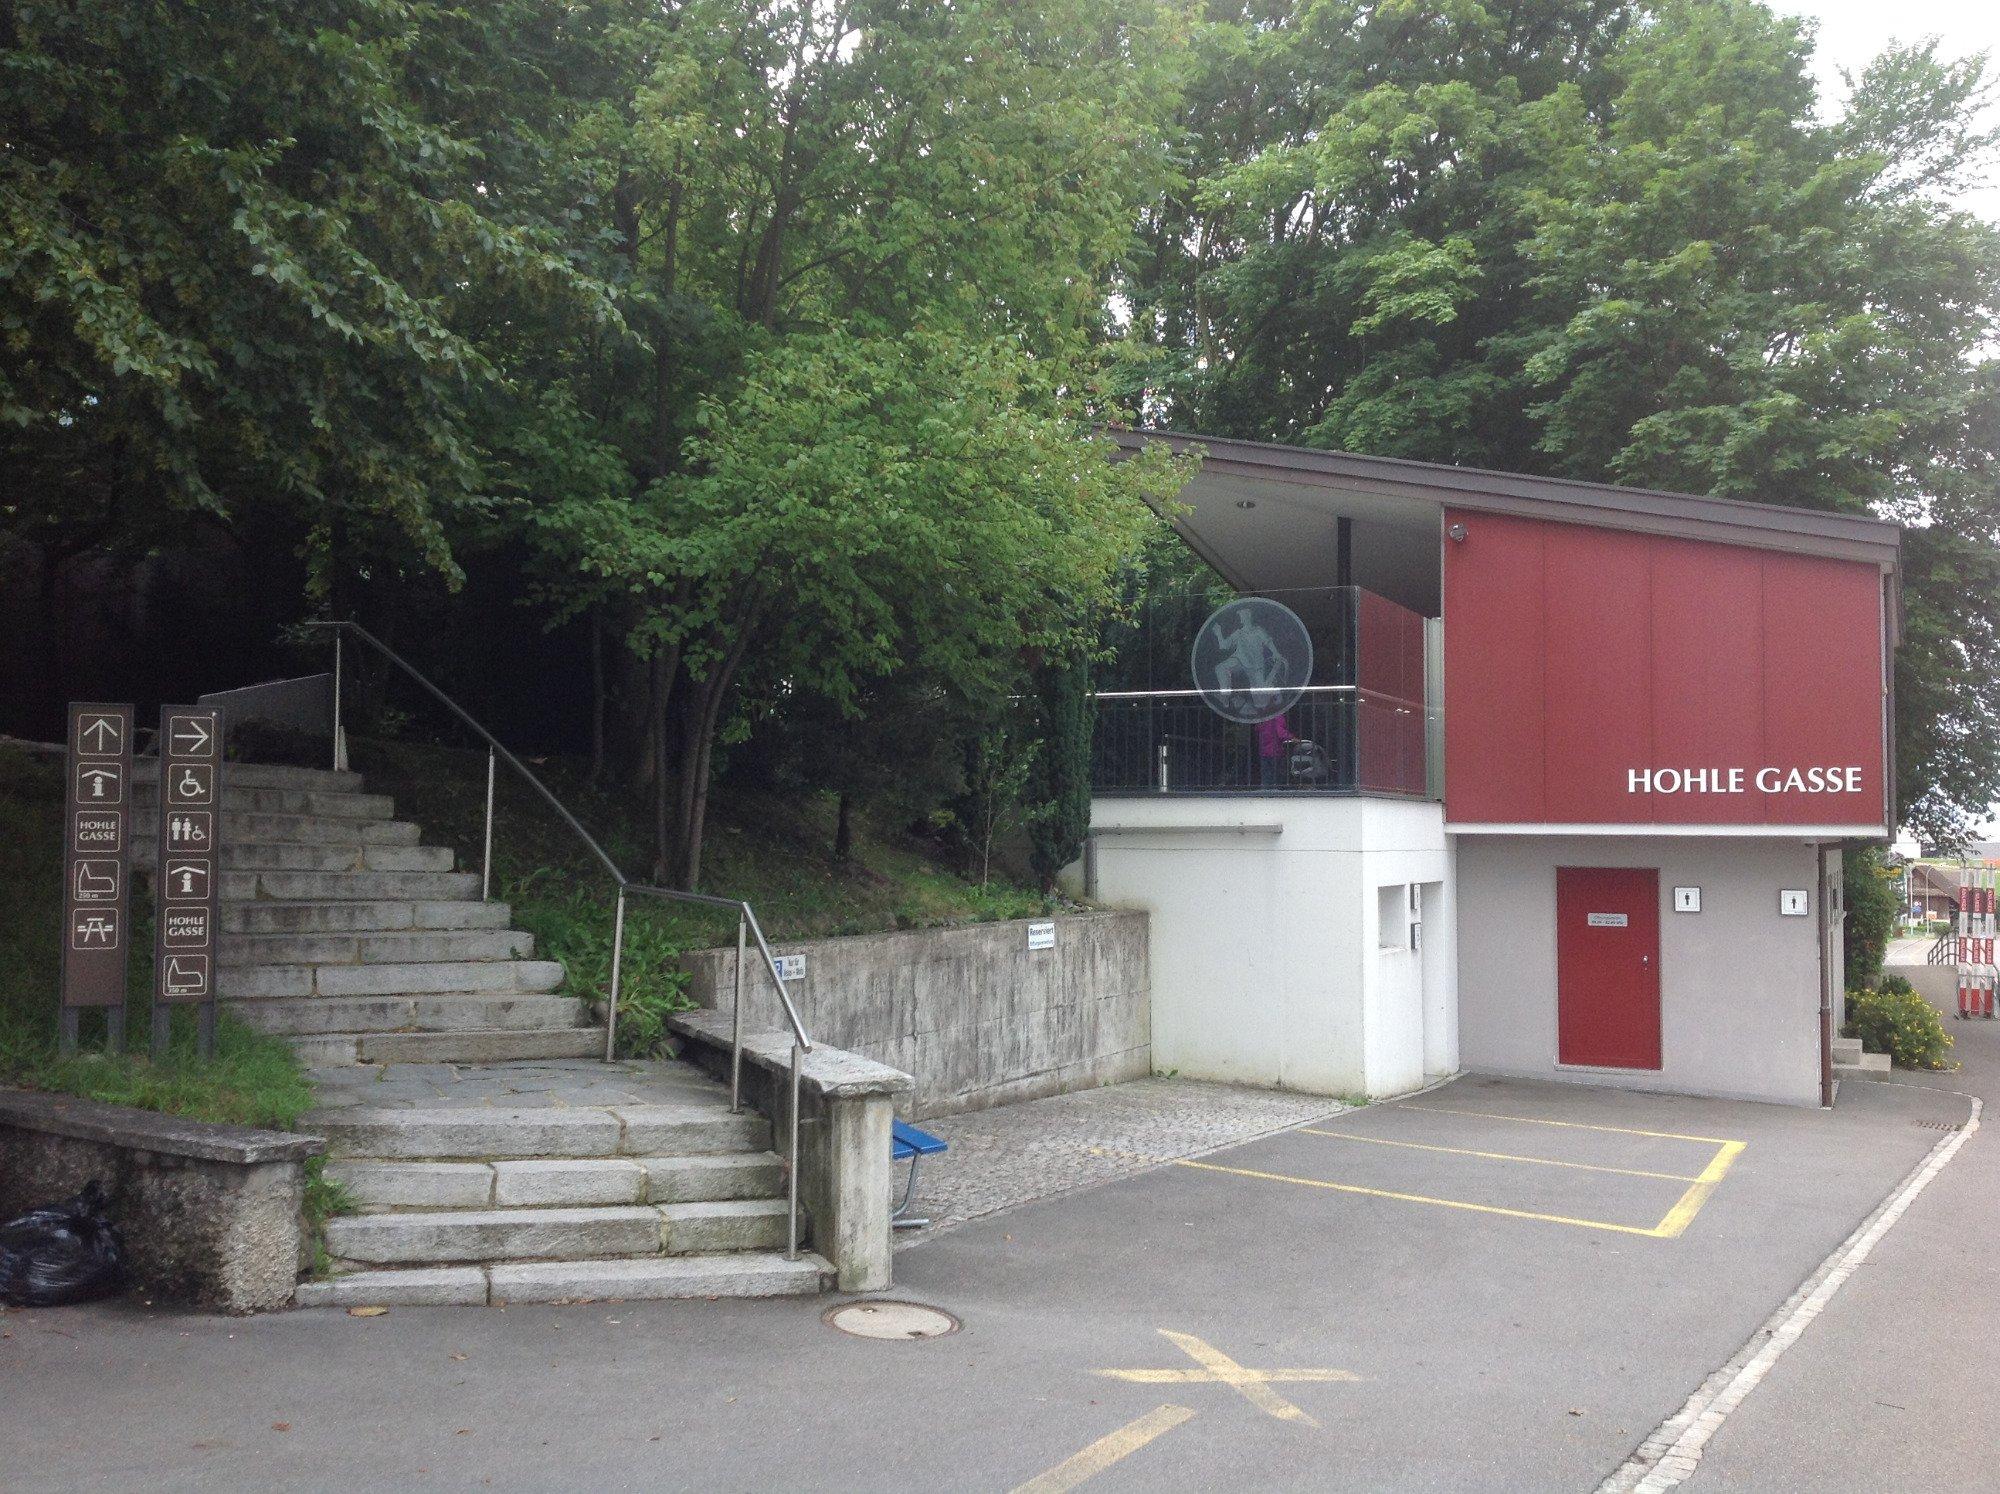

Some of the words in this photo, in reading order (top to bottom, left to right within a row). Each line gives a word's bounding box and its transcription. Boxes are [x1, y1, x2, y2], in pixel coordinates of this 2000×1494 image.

[1627, 768, 1745, 794] HOHLE
[1755, 766, 1863, 793] GASSE
[80, 821, 117, 830] HOHLE
[79, 831, 117, 841] GASSE
[168, 916, 205, 925] HOHLE
[168, 926, 205, 936] GASSE
